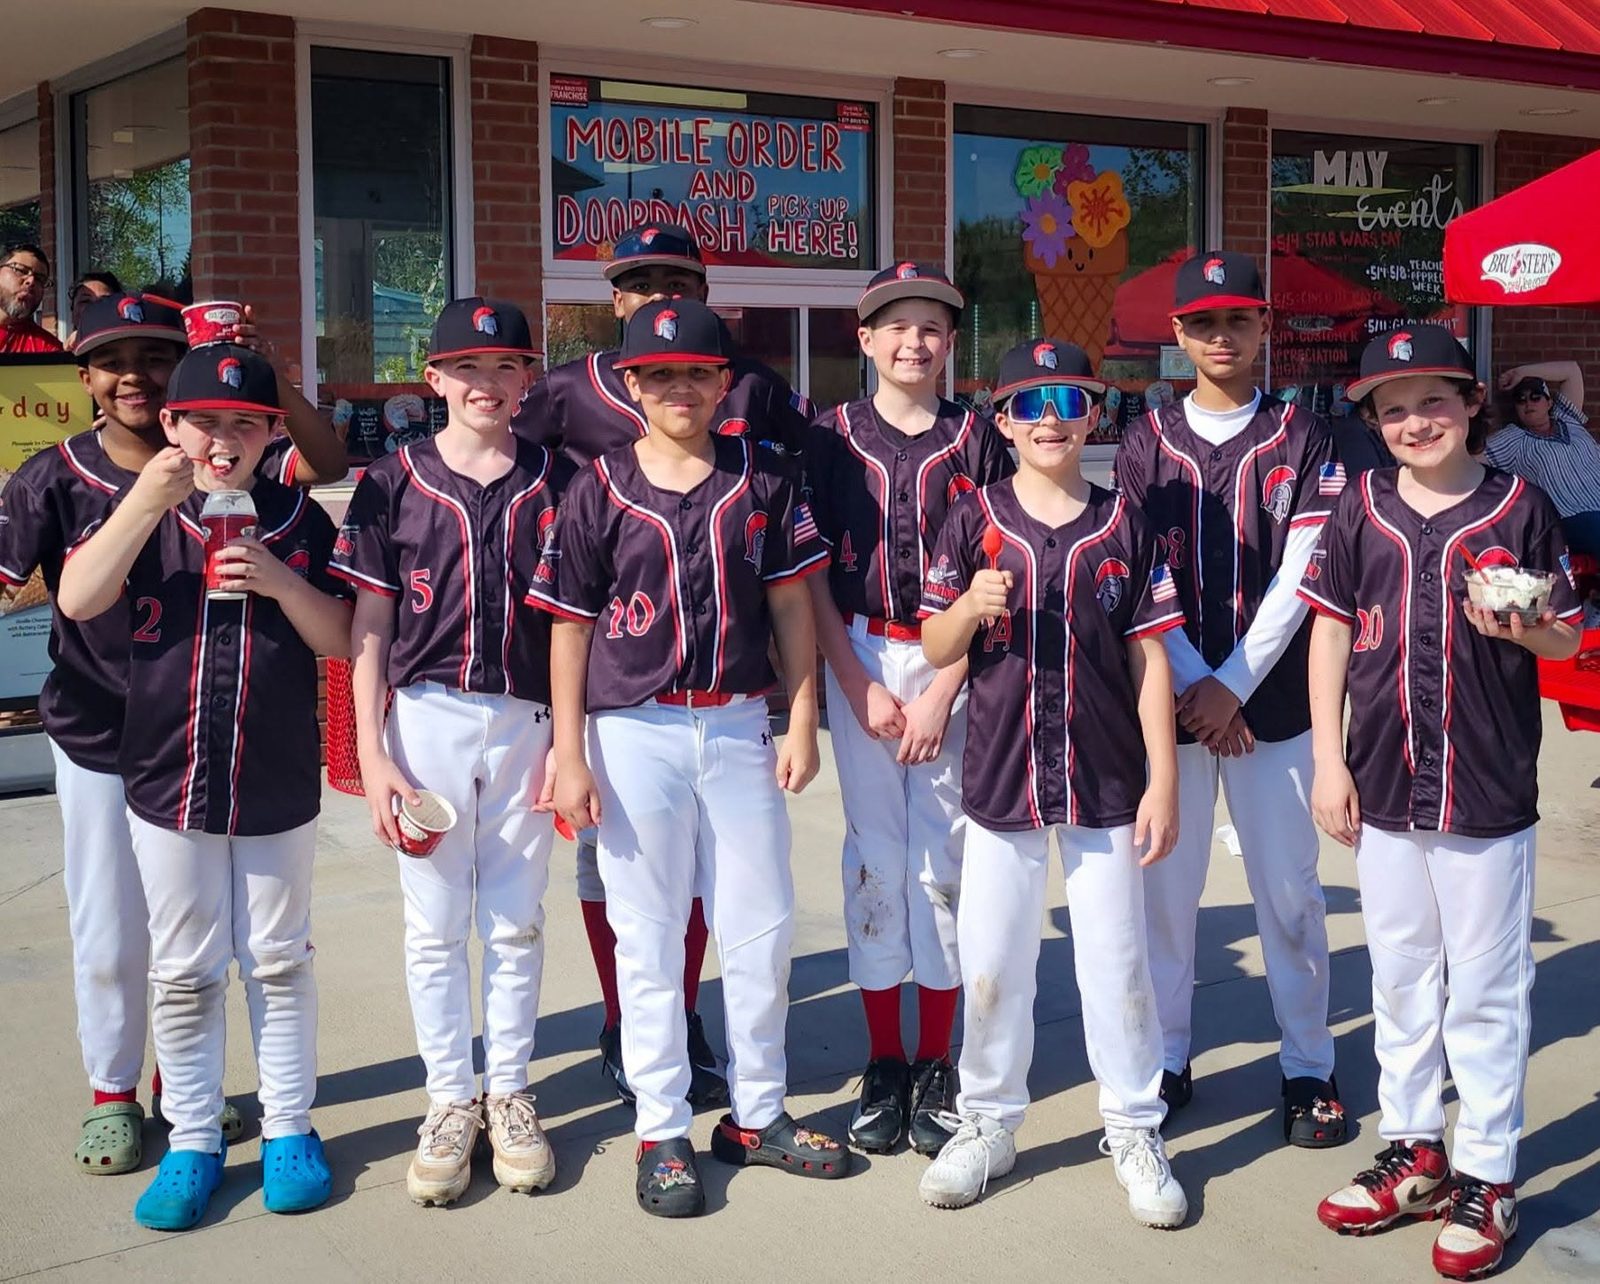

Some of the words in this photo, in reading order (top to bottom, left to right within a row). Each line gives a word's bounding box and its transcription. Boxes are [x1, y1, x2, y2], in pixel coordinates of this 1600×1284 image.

[551, 90, 588, 101] FRANCHISE
[567, 115, 713, 166] MOBILE
[727, 120, 845, 173] ORDER
[690, 170, 757, 202] AND
[1313, 150, 1388, 189] MAY
[1357, 174, 1464, 231] Events
[769, 219, 858, 258] HERE!
[1306, 231, 1336, 248] STAR
[1341, 230, 1378, 248] WARS
[1381, 230, 1400, 248] DAY
[1488, 253, 1555, 274] BRUSTER'S
[1412, 282, 1441, 296] WEEK
[839, 529, 858, 572] 4
[410, 568, 434, 614] 5
[133, 595, 163, 643] 2
[606, 591, 656, 639] 10
[1353, 604, 1384, 652] 20
